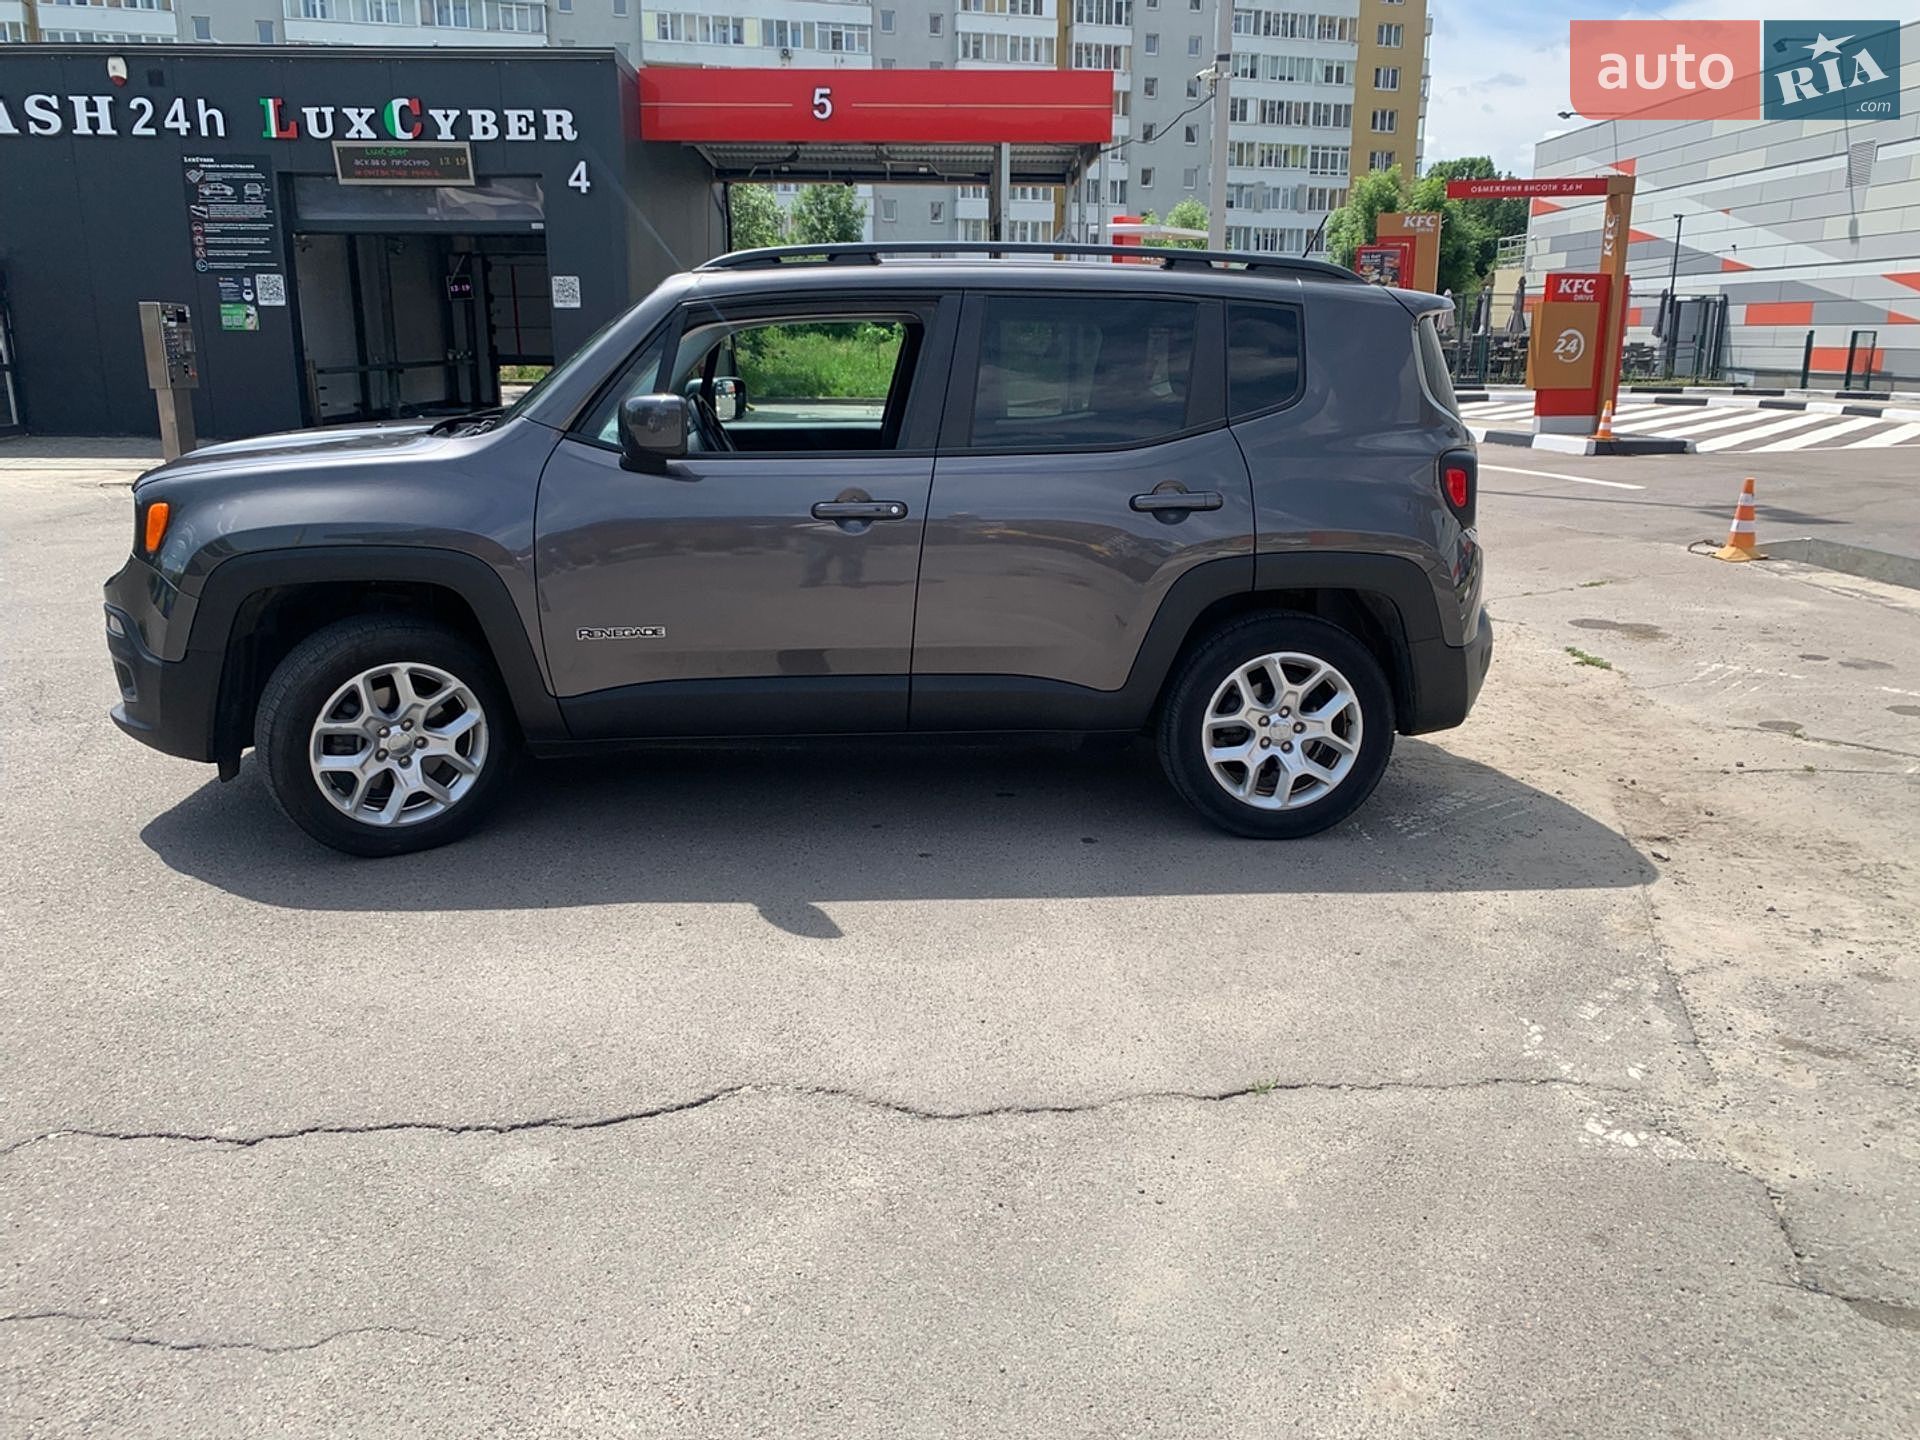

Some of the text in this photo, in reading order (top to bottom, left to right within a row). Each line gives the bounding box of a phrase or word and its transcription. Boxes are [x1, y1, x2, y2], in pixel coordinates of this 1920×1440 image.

[812, 87, 833, 120] 5
[129, 97, 226, 137] 24h
[568, 160, 592, 194] 4
[1403, 215, 1437, 227] KFC
[1603, 214, 1616, 256] KFC
[1558, 278, 1597, 294] KFC
[1553, 338, 1579, 353] 24
[575, 626, 665, 640] RENEGADE
